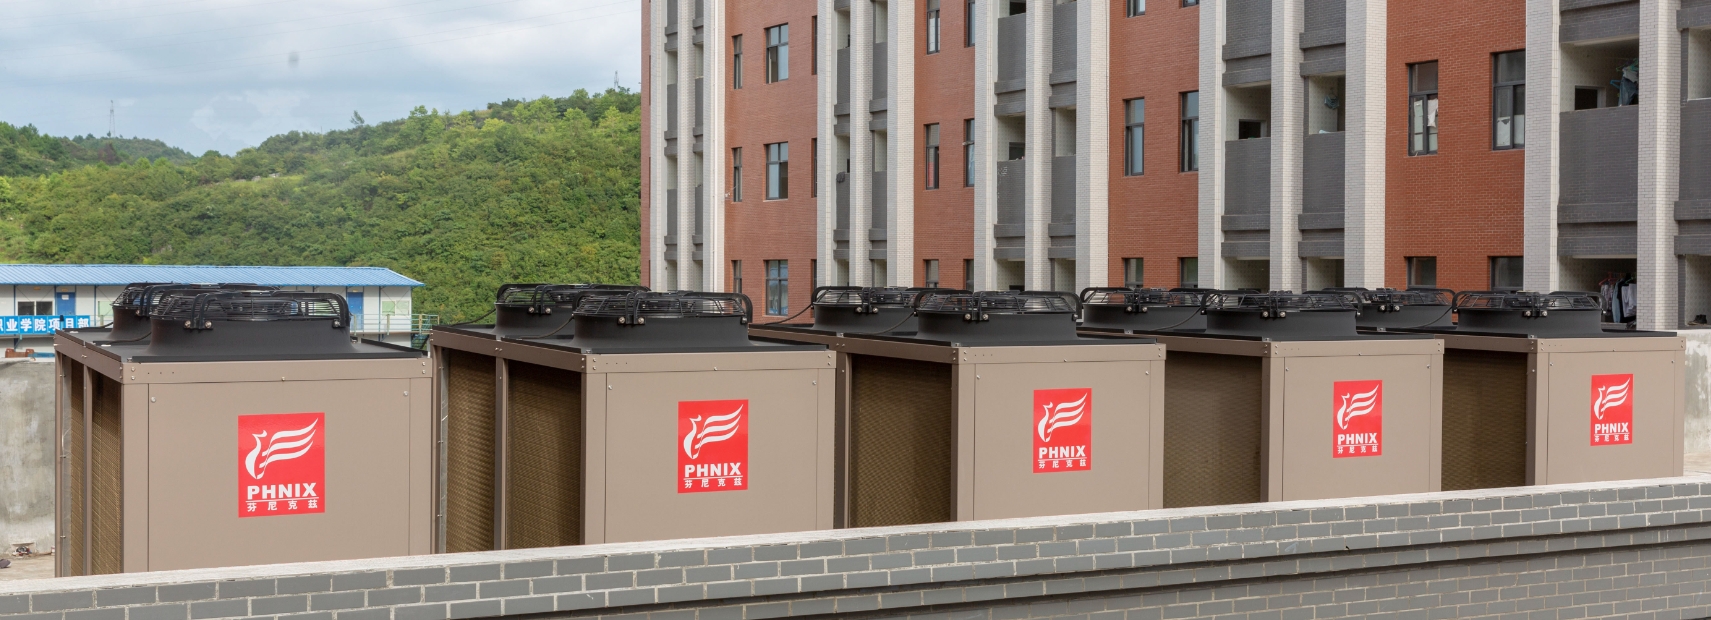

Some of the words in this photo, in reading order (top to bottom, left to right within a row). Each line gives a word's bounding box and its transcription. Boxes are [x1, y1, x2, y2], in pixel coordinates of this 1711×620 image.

[0, 317, 90, 331] 业学院项目部
[1594, 422, 1629, 434] PHNIX
[1337, 432, 1377, 445] PHNIX
[1038, 445, 1086, 459] PHNIX
[684, 462, 742, 478] PHNIX
[247, 482, 317, 501] PHNIX
[246, 499, 318, 512] 芬尼克兹
